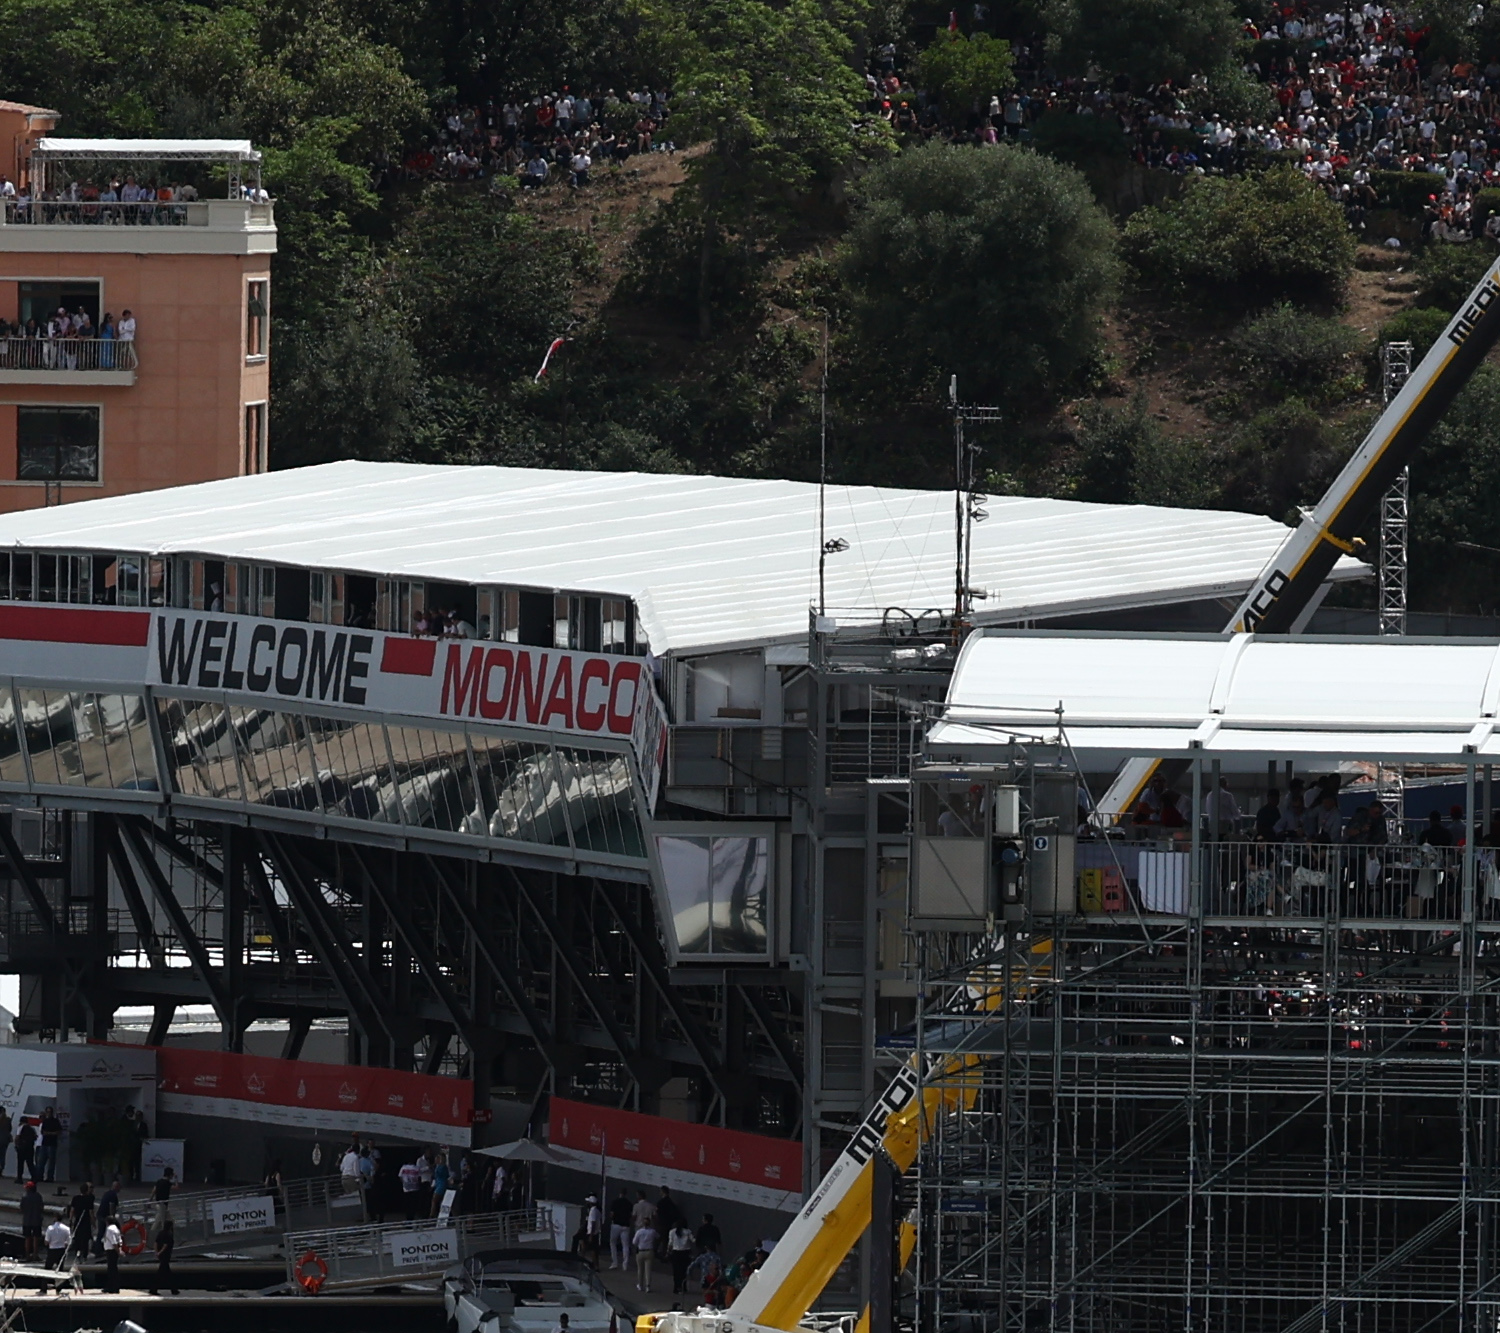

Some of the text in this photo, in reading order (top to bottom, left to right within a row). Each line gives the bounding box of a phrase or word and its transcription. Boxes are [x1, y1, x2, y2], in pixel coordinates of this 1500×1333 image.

[157, 615, 373, 705] WELCOME
[440, 644, 643, 735] MONACO
[222, 1209, 267, 1222] PONTON
[401, 1242, 449, 1255] PONTON
